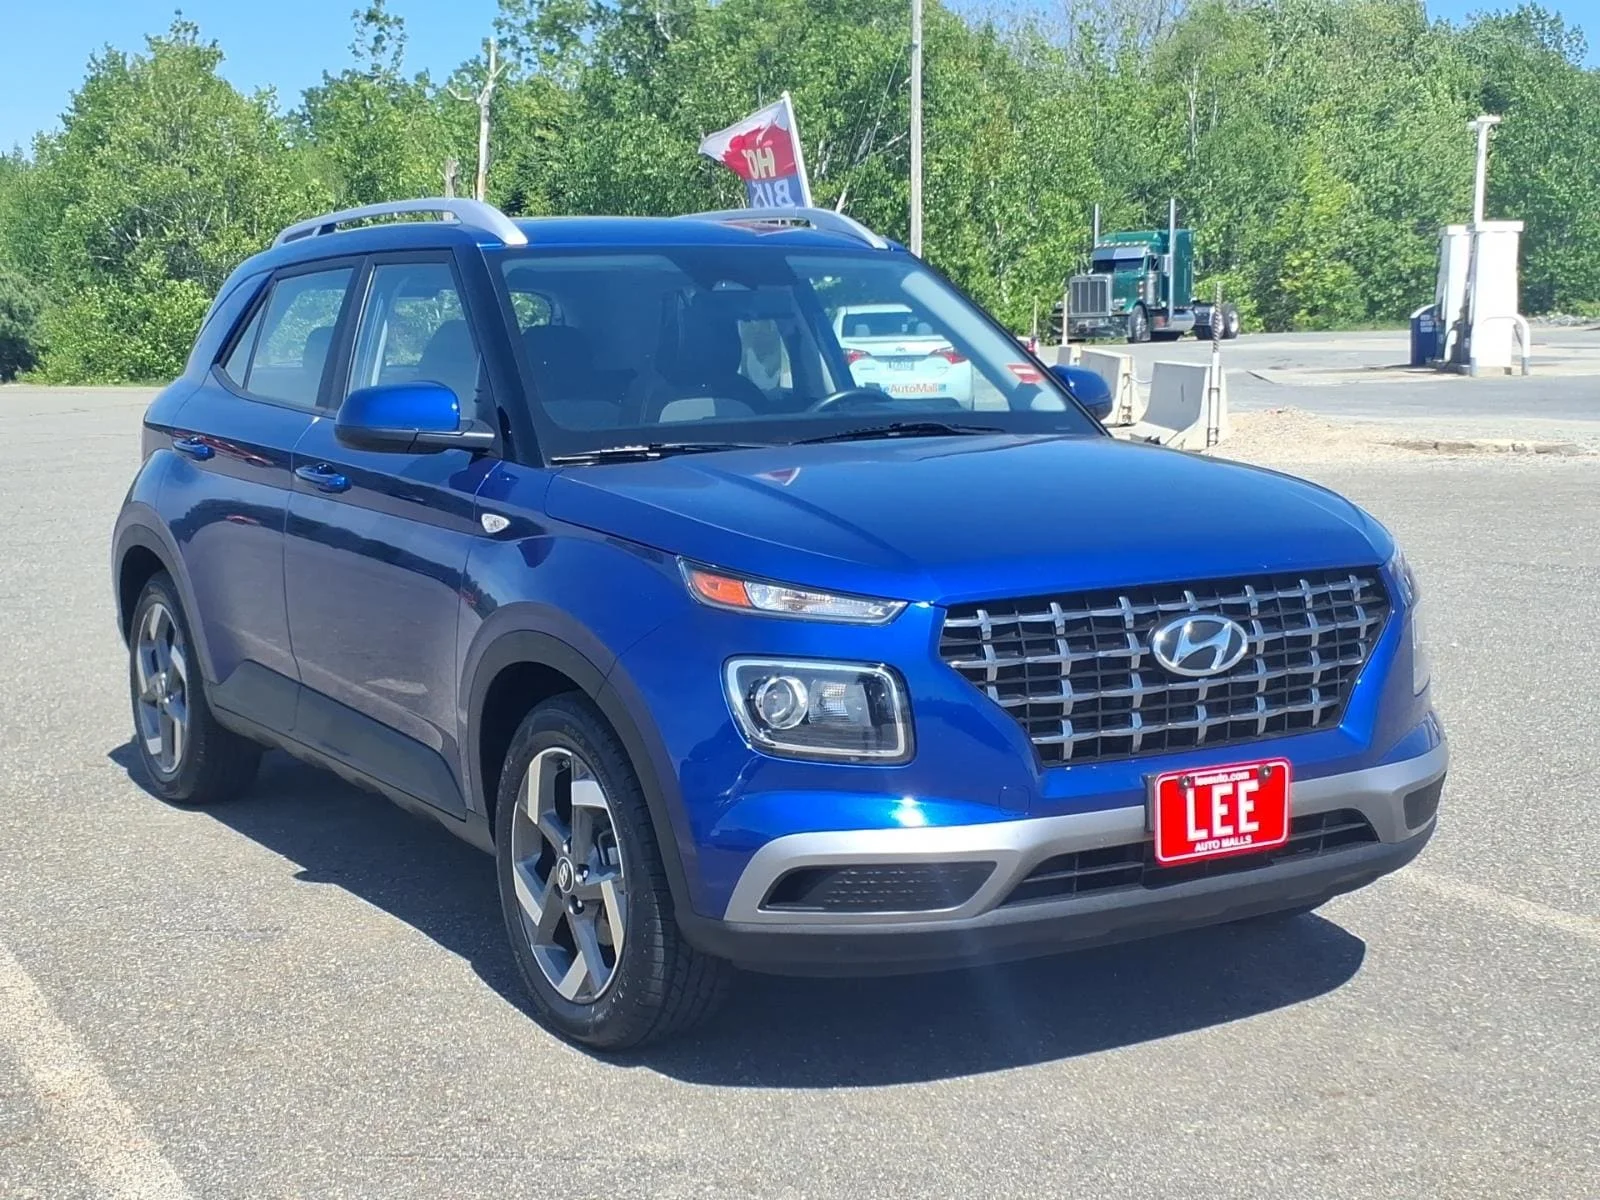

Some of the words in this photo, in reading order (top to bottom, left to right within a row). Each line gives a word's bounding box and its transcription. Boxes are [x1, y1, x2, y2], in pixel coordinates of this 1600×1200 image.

[1186, 779, 1259, 842] LEE
[1194, 840, 1220, 852] AUTO
[1221, 835, 1252, 848] MALLS
